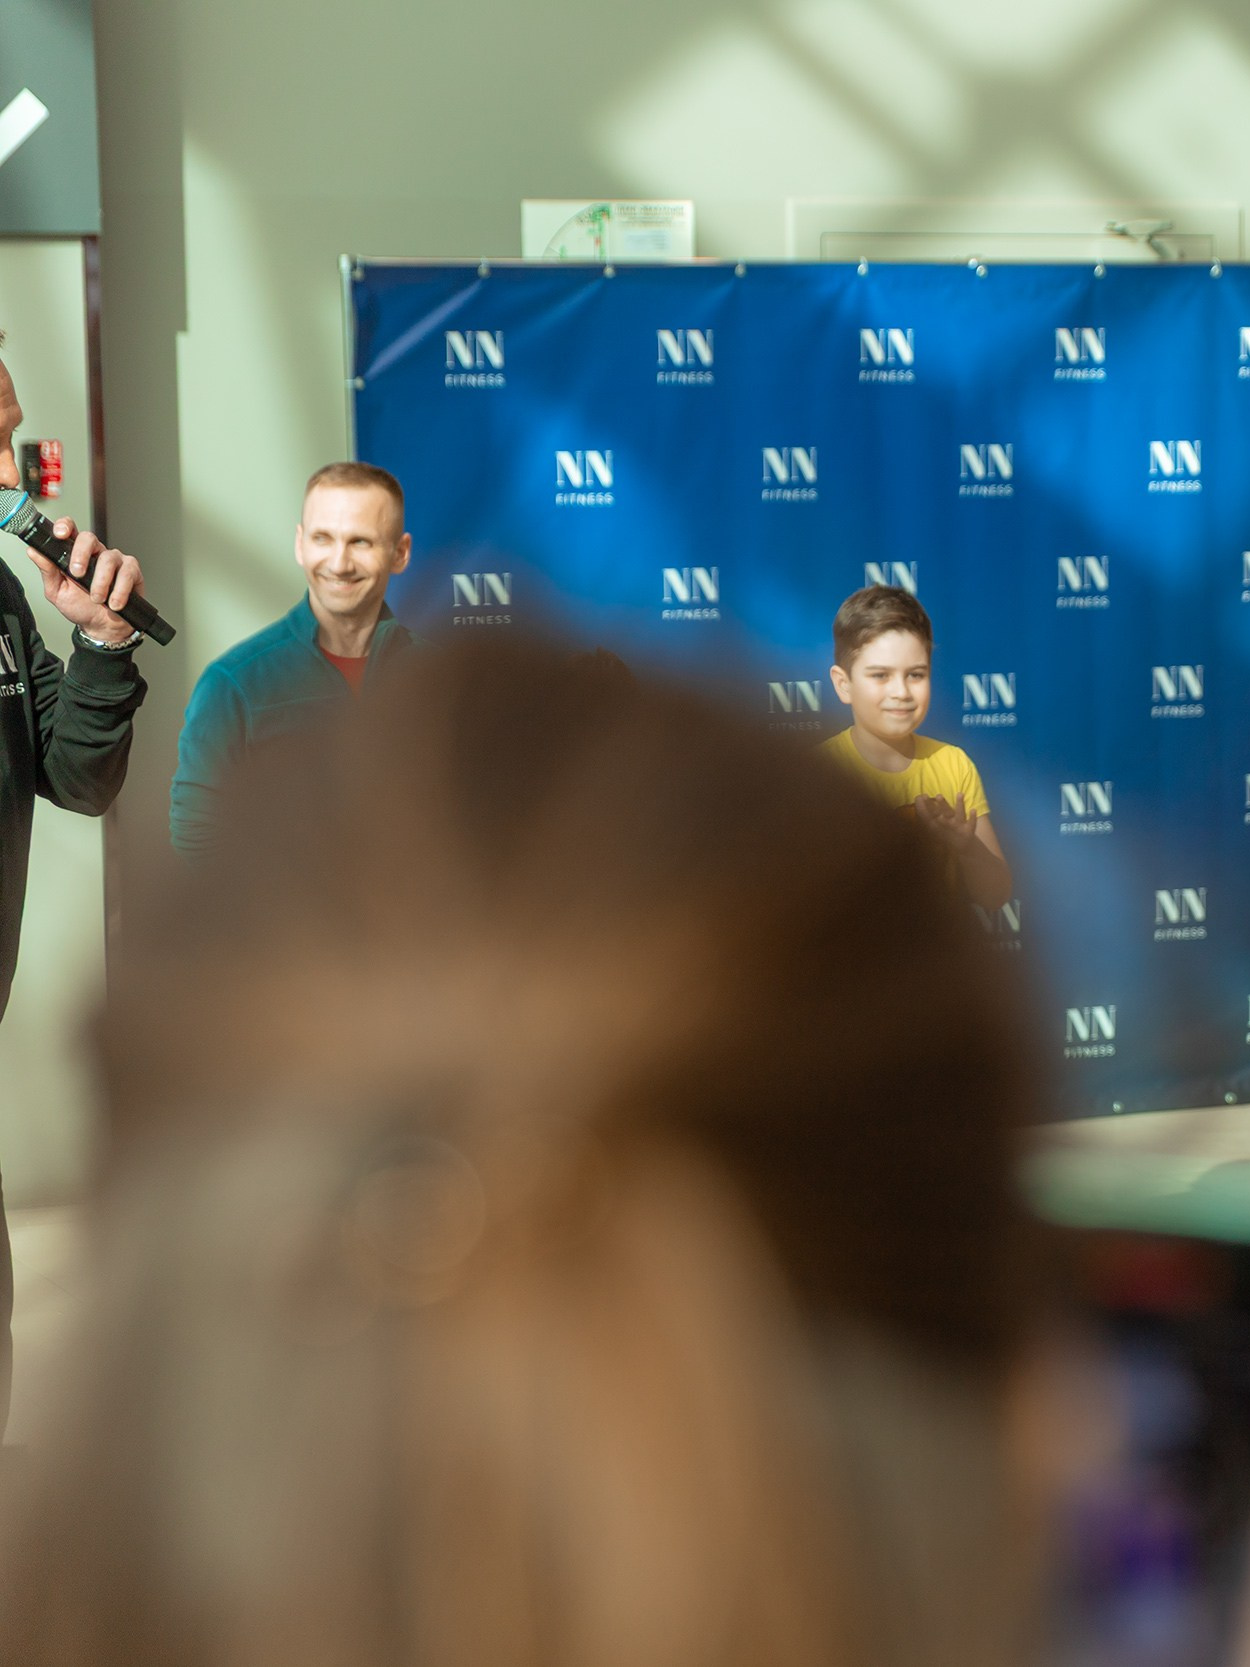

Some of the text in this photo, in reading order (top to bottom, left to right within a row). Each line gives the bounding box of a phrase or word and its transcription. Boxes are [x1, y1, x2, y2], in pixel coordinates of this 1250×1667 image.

[446, 331, 504, 369] NN
[657, 329, 713, 366] NN
[860, 328, 914, 365] NN
[1056, 327, 1105, 363] NN
[445, 373, 505, 386] FITNESS
[657, 371, 713, 384] FITNESS
[859, 370, 914, 382] FITNESS
[1054, 368, 1106, 379] FITNESS
[556, 450, 613, 487] NN
[763, 447, 817, 483] NN
[961, 444, 1013, 479] NN
[1149, 440, 1201, 476] NN
[555, 493, 613, 505] FITNESS
[761, 488, 817, 501] FITNESS
[959, 484, 1013, 496] FITNESS
[1148, 480, 1201, 492] FITNESS
[663, 567, 719, 603] NN
[864, 561, 918, 596] NN
[1058, 556, 1108, 591] NN
[452, 573, 511, 607] NN
[1056, 596, 1109, 608] FITNESS
[453, 615, 511, 625] FITNESS
[662, 608, 720, 620] FITNESS
[769, 681, 821, 712] NN
[963, 673, 1016, 709] NN
[1152, 665, 1203, 701] NN
[962, 713, 1017, 726] FITNESS
[1151, 704, 1204, 717] FITNESS
[1060, 782, 1112, 818] NN
[1060, 821, 1112, 834] FITNESS
[1155, 888, 1205, 924] NN
[1154, 927, 1207, 940] FITNESS
[1067, 1005, 1116, 1041] NN
[1064, 1045, 1115, 1057] FITNESS
